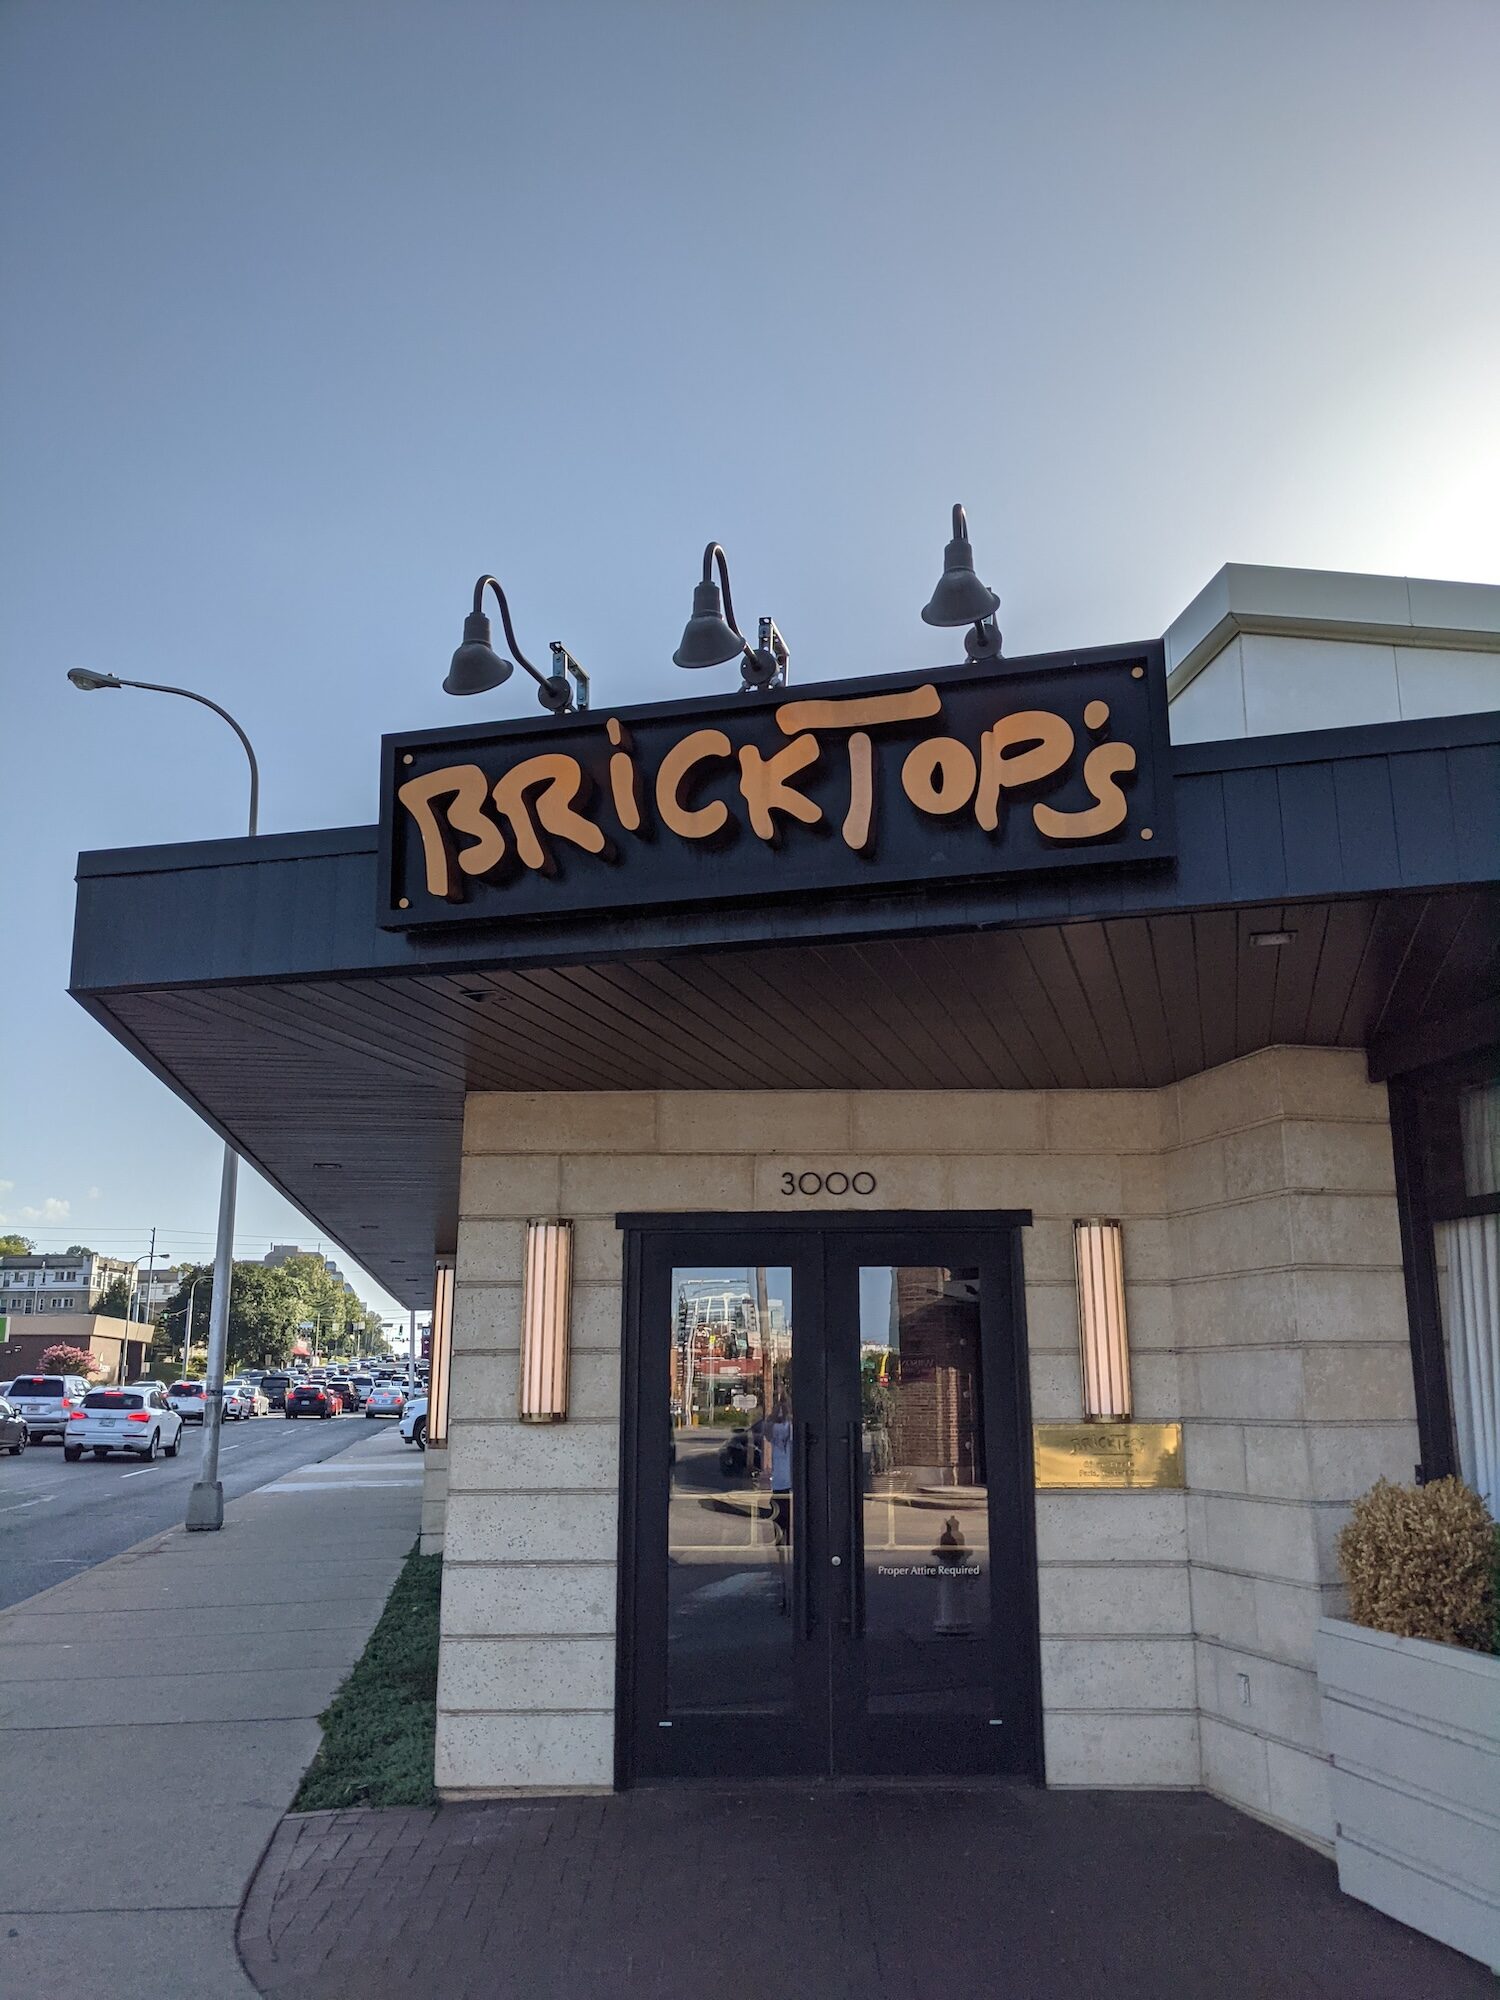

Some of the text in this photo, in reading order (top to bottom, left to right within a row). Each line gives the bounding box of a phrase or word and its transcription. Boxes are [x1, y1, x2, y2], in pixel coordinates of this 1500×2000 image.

[781, 1172, 876, 1196] 3000
[878, 1565, 980, 1577] Proper Attire Required
